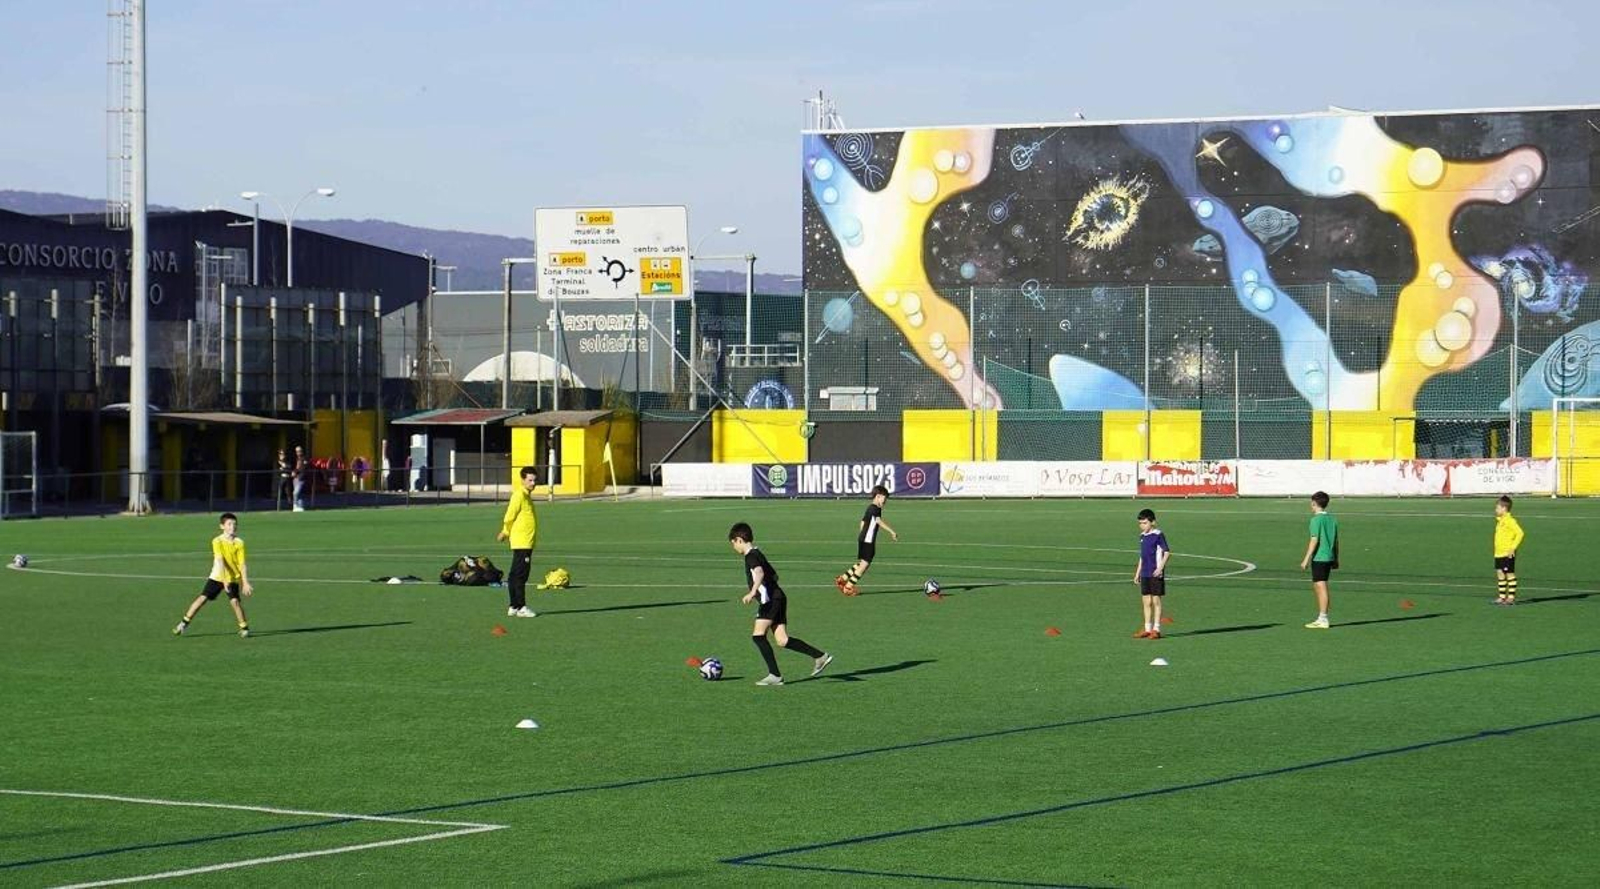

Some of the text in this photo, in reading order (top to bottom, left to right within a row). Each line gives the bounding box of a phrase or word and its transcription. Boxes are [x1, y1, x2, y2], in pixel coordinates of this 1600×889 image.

[588, 213, 610, 223] porto
[606, 227, 615, 235] de
[570, 237, 621, 246] reparaciones
[633, 245, 659, 253] centro
[125, 248, 179, 272] ZNA
[561, 254, 584, 265] porto
[543, 267, 593, 275] Zona Franca
[551, 277, 585, 285] Terminal
[562, 287, 590, 295] Bouzas
[579, 333, 649, 353] soldadura
[797, 464, 896, 494] IMPULSO23
[1055, 468, 1093, 485] Voso
[1097, 468, 1134, 486] Lar
